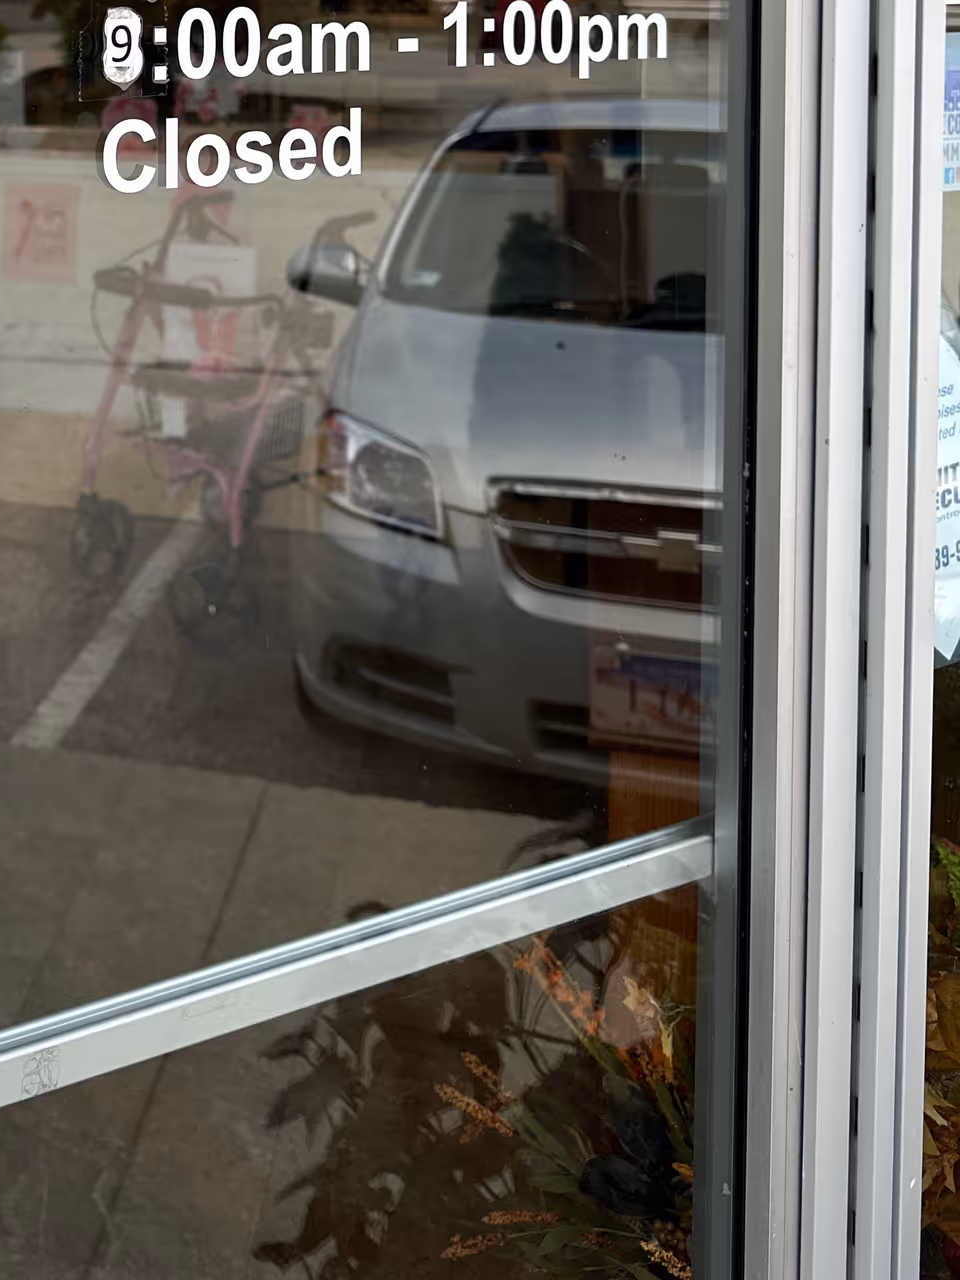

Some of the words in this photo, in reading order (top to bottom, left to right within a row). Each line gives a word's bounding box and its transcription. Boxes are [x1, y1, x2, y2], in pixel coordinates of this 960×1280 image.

[103, 7, 369, 84] 9:00am
[399, 39, 418, 51] -
[444, 0, 666, 78] 1:00pm
[104, 108, 361, 193] Closed
